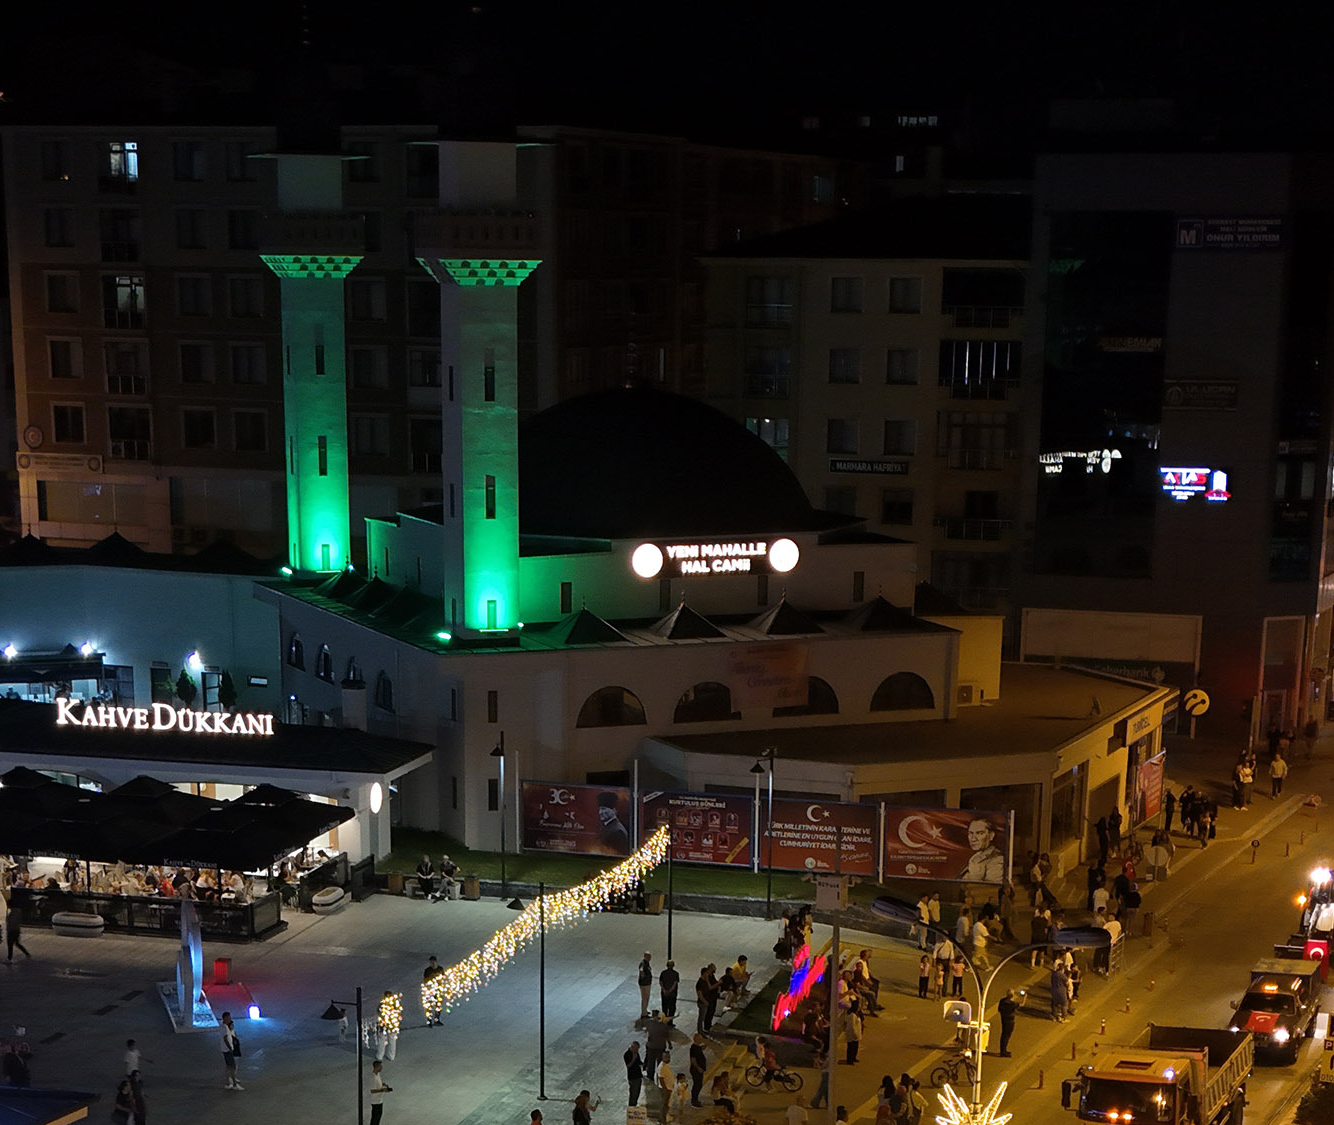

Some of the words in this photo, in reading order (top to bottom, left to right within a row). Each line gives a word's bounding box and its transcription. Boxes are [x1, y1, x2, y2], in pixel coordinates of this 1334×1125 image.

[701, 542, 767, 558] MAHALLE
[681, 559, 711, 574] HAL
[56, 697, 149, 731] KAHVE
[152, 702, 275, 736] DÜKKANI
[764, 830, 801, 839] AETLERİNE
